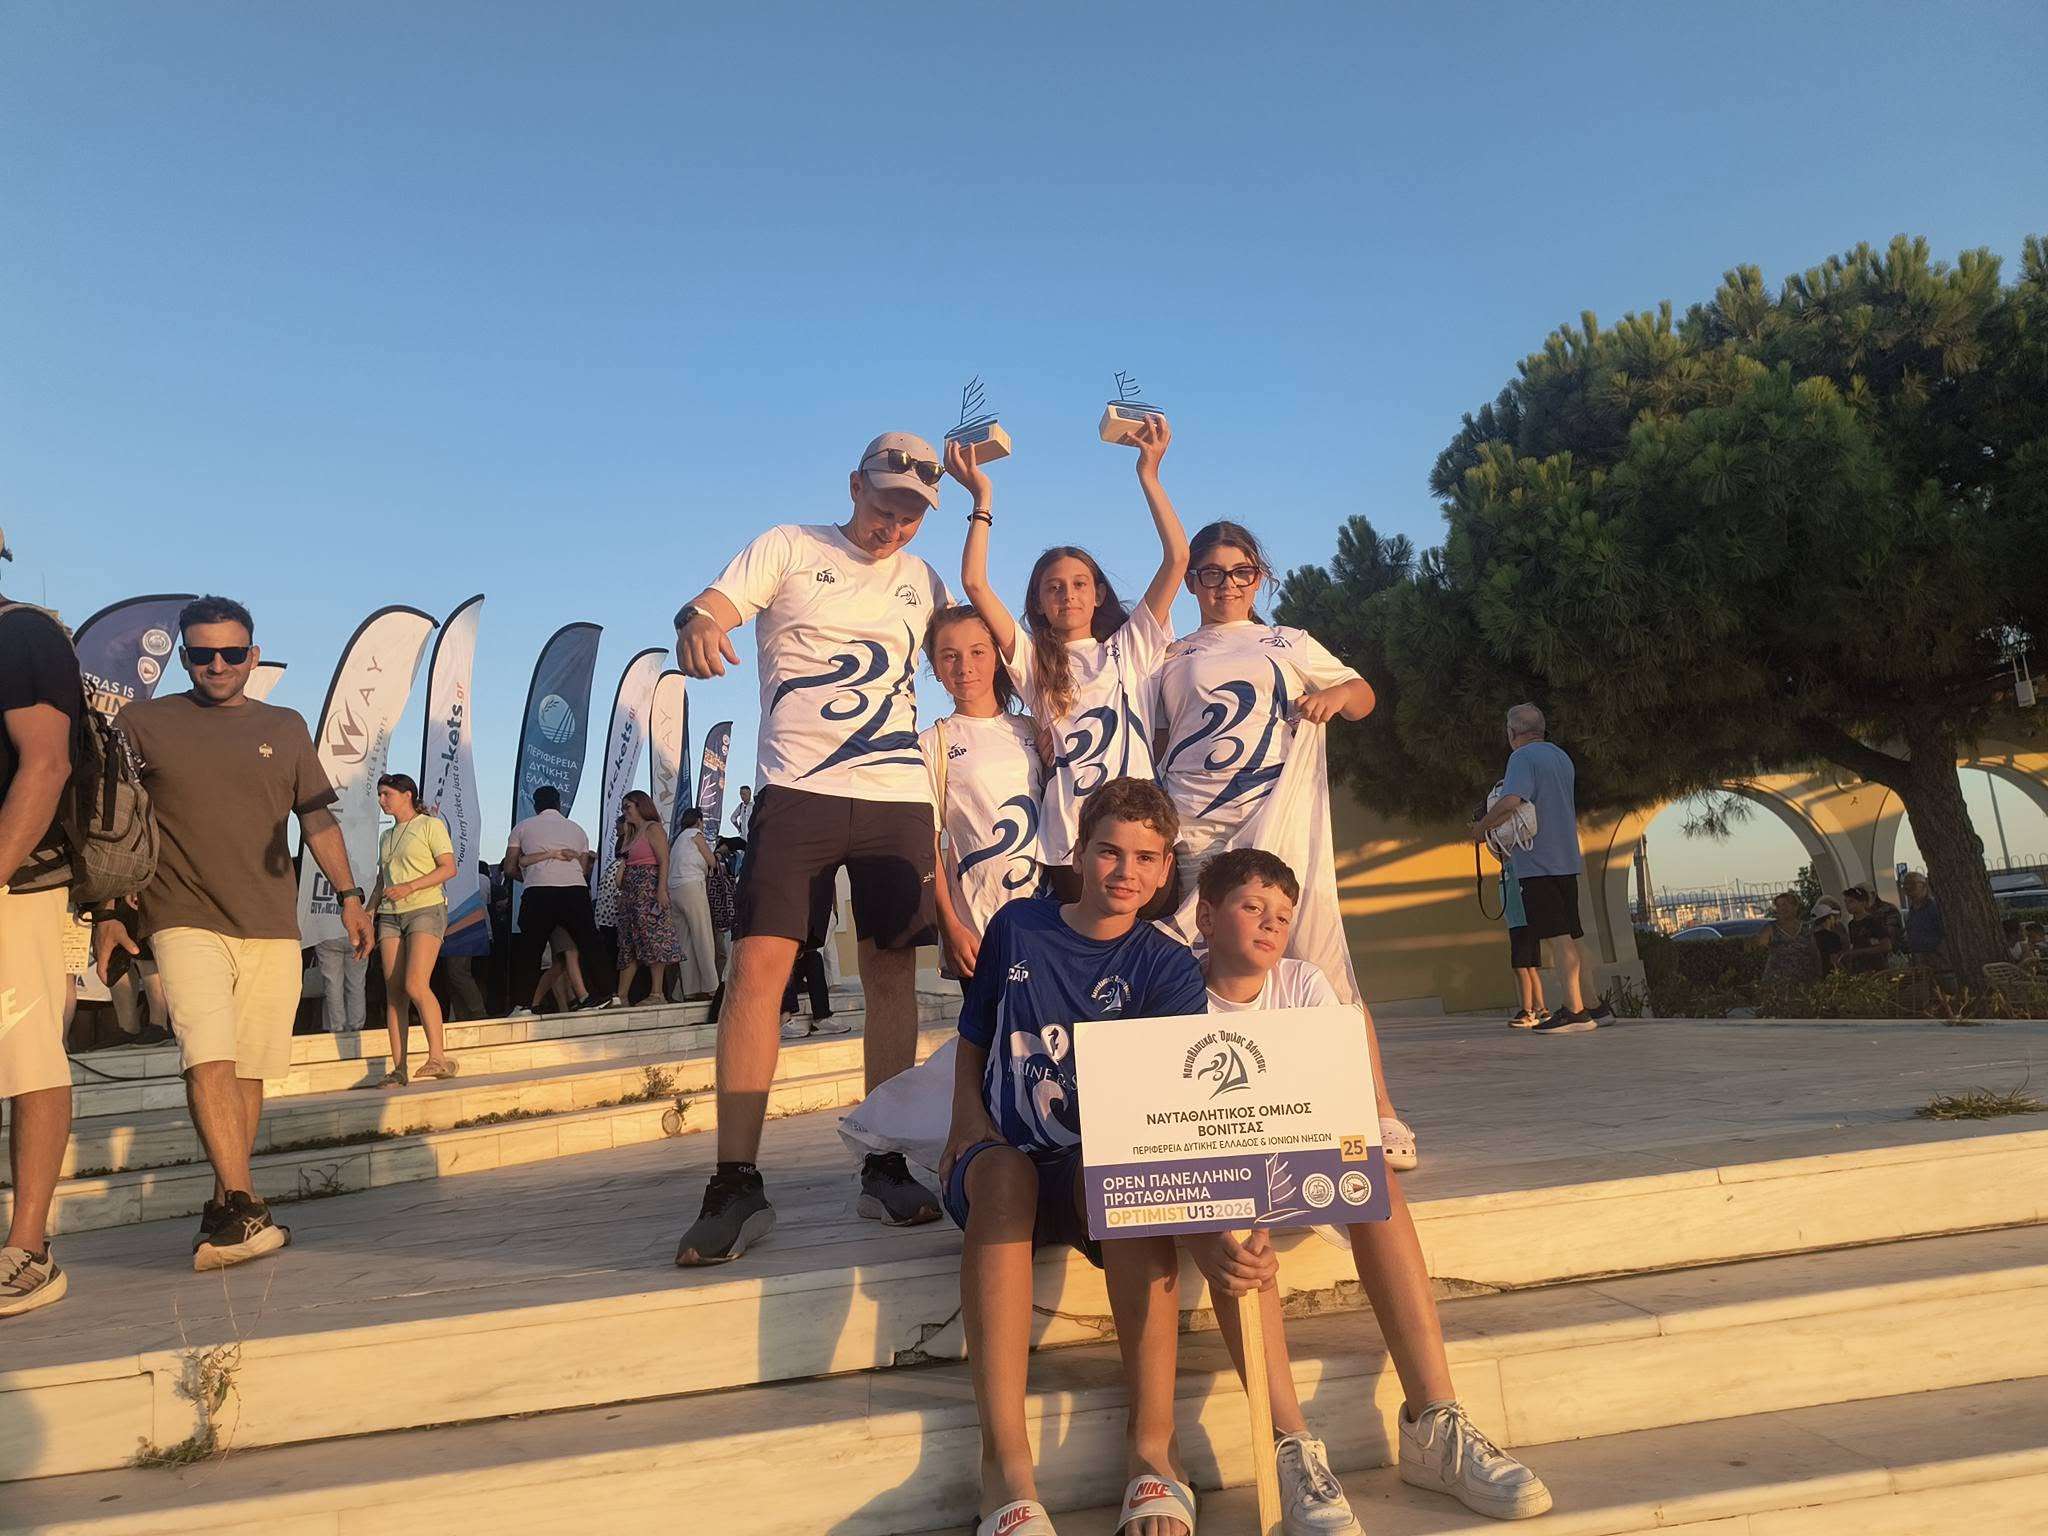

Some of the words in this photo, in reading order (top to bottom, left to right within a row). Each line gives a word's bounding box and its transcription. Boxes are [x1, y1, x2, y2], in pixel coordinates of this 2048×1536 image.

[816, 572, 835, 584] CAP
[84, 672, 120, 693] TRAS
[123, 685, 135, 698] IS
[527, 744, 578, 769] ΠΕΡΙΦΕΡΕΙΑ
[947, 747, 967, 760] CAP
[529, 762, 570, 780] ΔΥΤΙΚΗΣ
[1008, 968, 1029, 982] CAP
[1146, 1106, 1256, 1125] ΝΑΥΤΑΘΛΗΤΙΚΟΣ
[1258, 1102, 1312, 1117] ΟΜΙΛΟΣ
[1198, 1121, 1264, 1137] ΒΟΝΙΤΣΑΣ
[1133, 1144, 1182, 1155] ΠΕΡΙΦΕΡΕΙΑ
[1183, 1141, 1218, 1152] ΔΥΤΙΚΗΣ
[1219, 1137, 1259, 1149] ΕΛΛΑΔΟΣ
[1260, 1137, 1267, 1146] &
[1268, 1134, 1300, 1146] ΙΟΝΙΩΝ
[1301, 1132, 1332, 1144] ΝΗΣΩΝ
[1343, 1140, 1363, 1156] 25
[1103, 1175, 1145, 1191] OPEN
[1150, 1167, 1252, 1188] ΠΑΝΕΛΛΗΝΙΟ
[1103, 1186, 1211, 1206] ΠΡΩΤΑΘΛΗΜΑ
[1135, 1481, 1170, 1497] NIKE
[1000, 1505, 1031, 1529] NIKE
